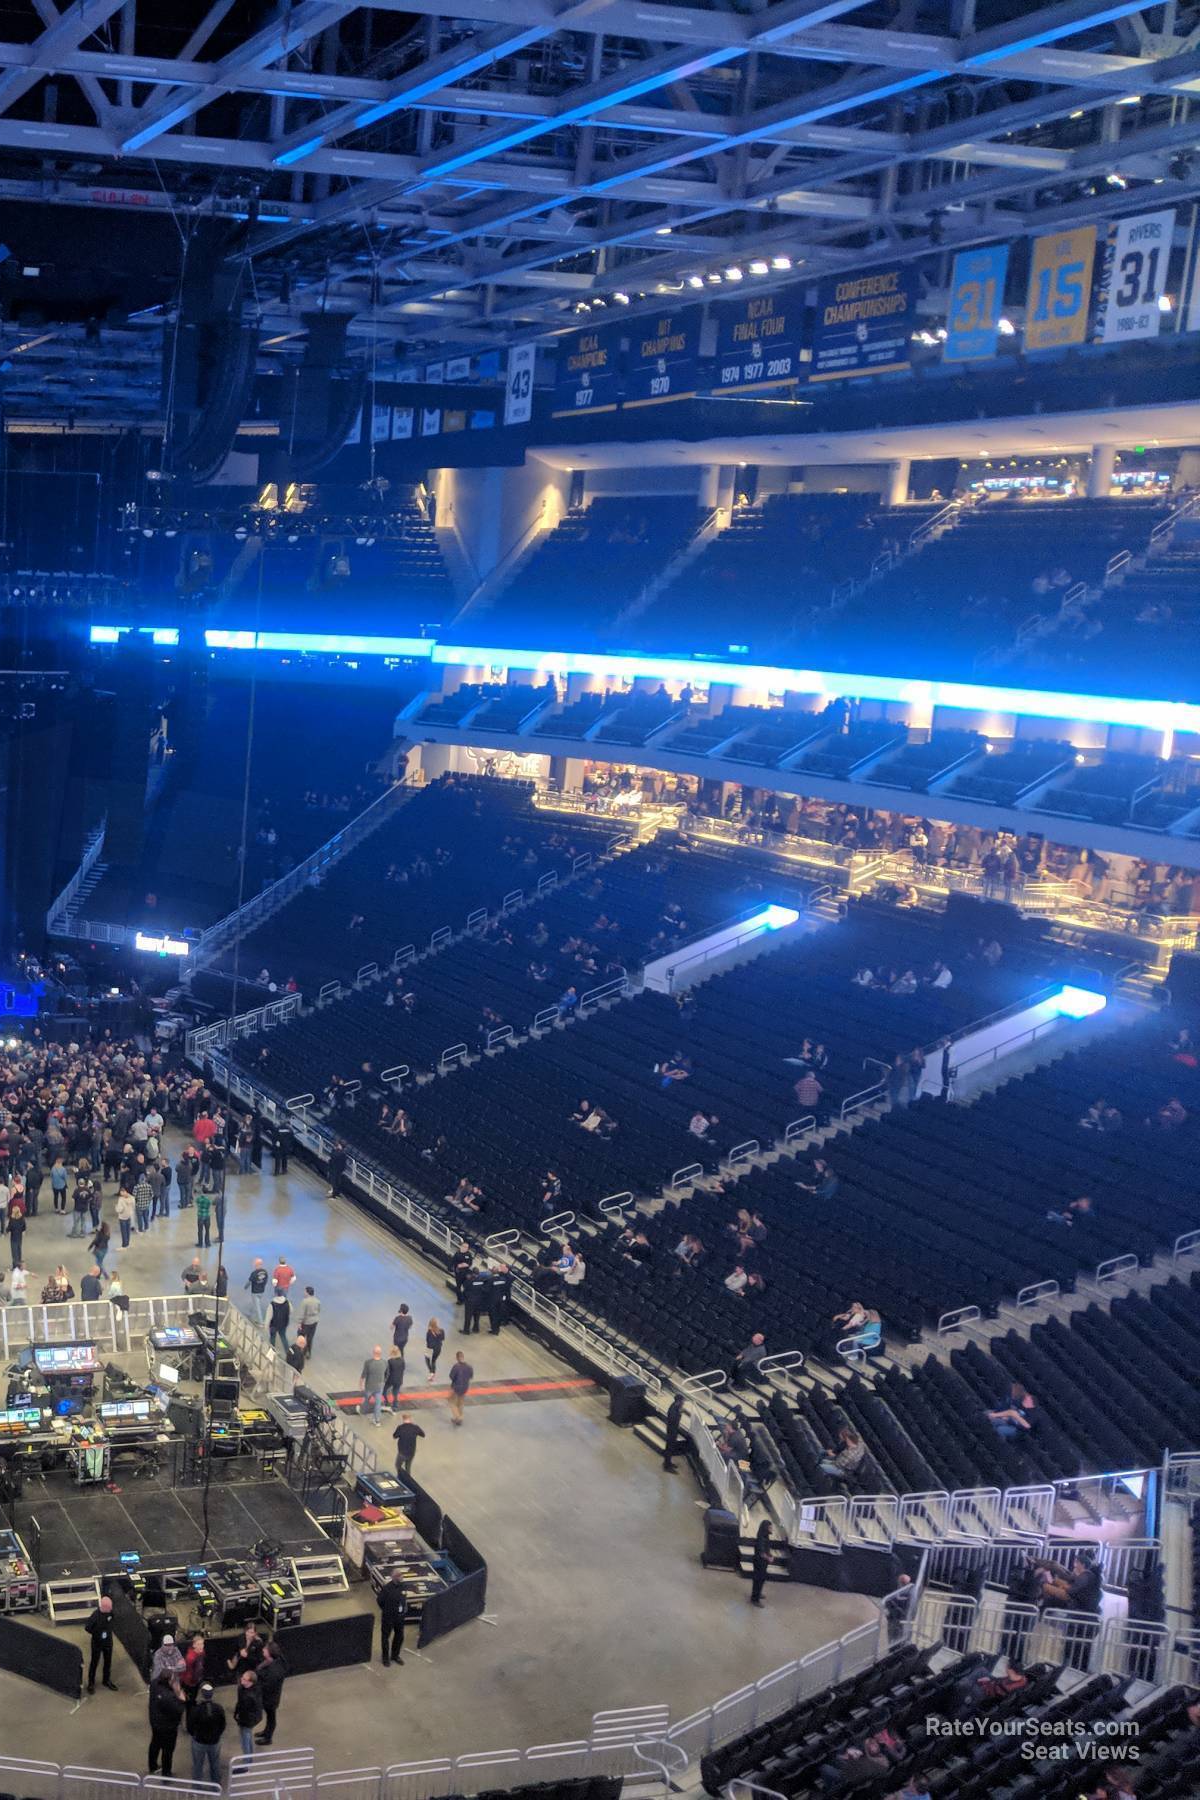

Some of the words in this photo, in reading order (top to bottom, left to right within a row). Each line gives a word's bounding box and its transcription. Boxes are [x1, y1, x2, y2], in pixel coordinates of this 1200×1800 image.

[1129, 223, 1162, 245] RIVERS
[836, 273, 899, 301] CONFERENCE
[1116, 247, 1160, 307] 31
[1033, 262, 1085, 321] 15
[748, 298, 774, 320] NCAA
[824, 292, 908, 325] CHAMPIONSHIPS
[955, 278, 996, 332] 31
[733, 321, 758, 342] FINAL
[761, 317, 785, 337] FOUR
[579, 334, 599, 352] NCAA
[641, 332, 687, 357] CHAMPIONS
[567, 349, 608, 371] CHAMPIONS
[721, 365, 740, 383] 1974
[743, 362, 764, 381] 1977
[767, 358, 792, 376] 2003
[512, 369, 531, 400] 43
[650, 376, 671, 395] 1970
[575, 389, 594, 406] 1977
